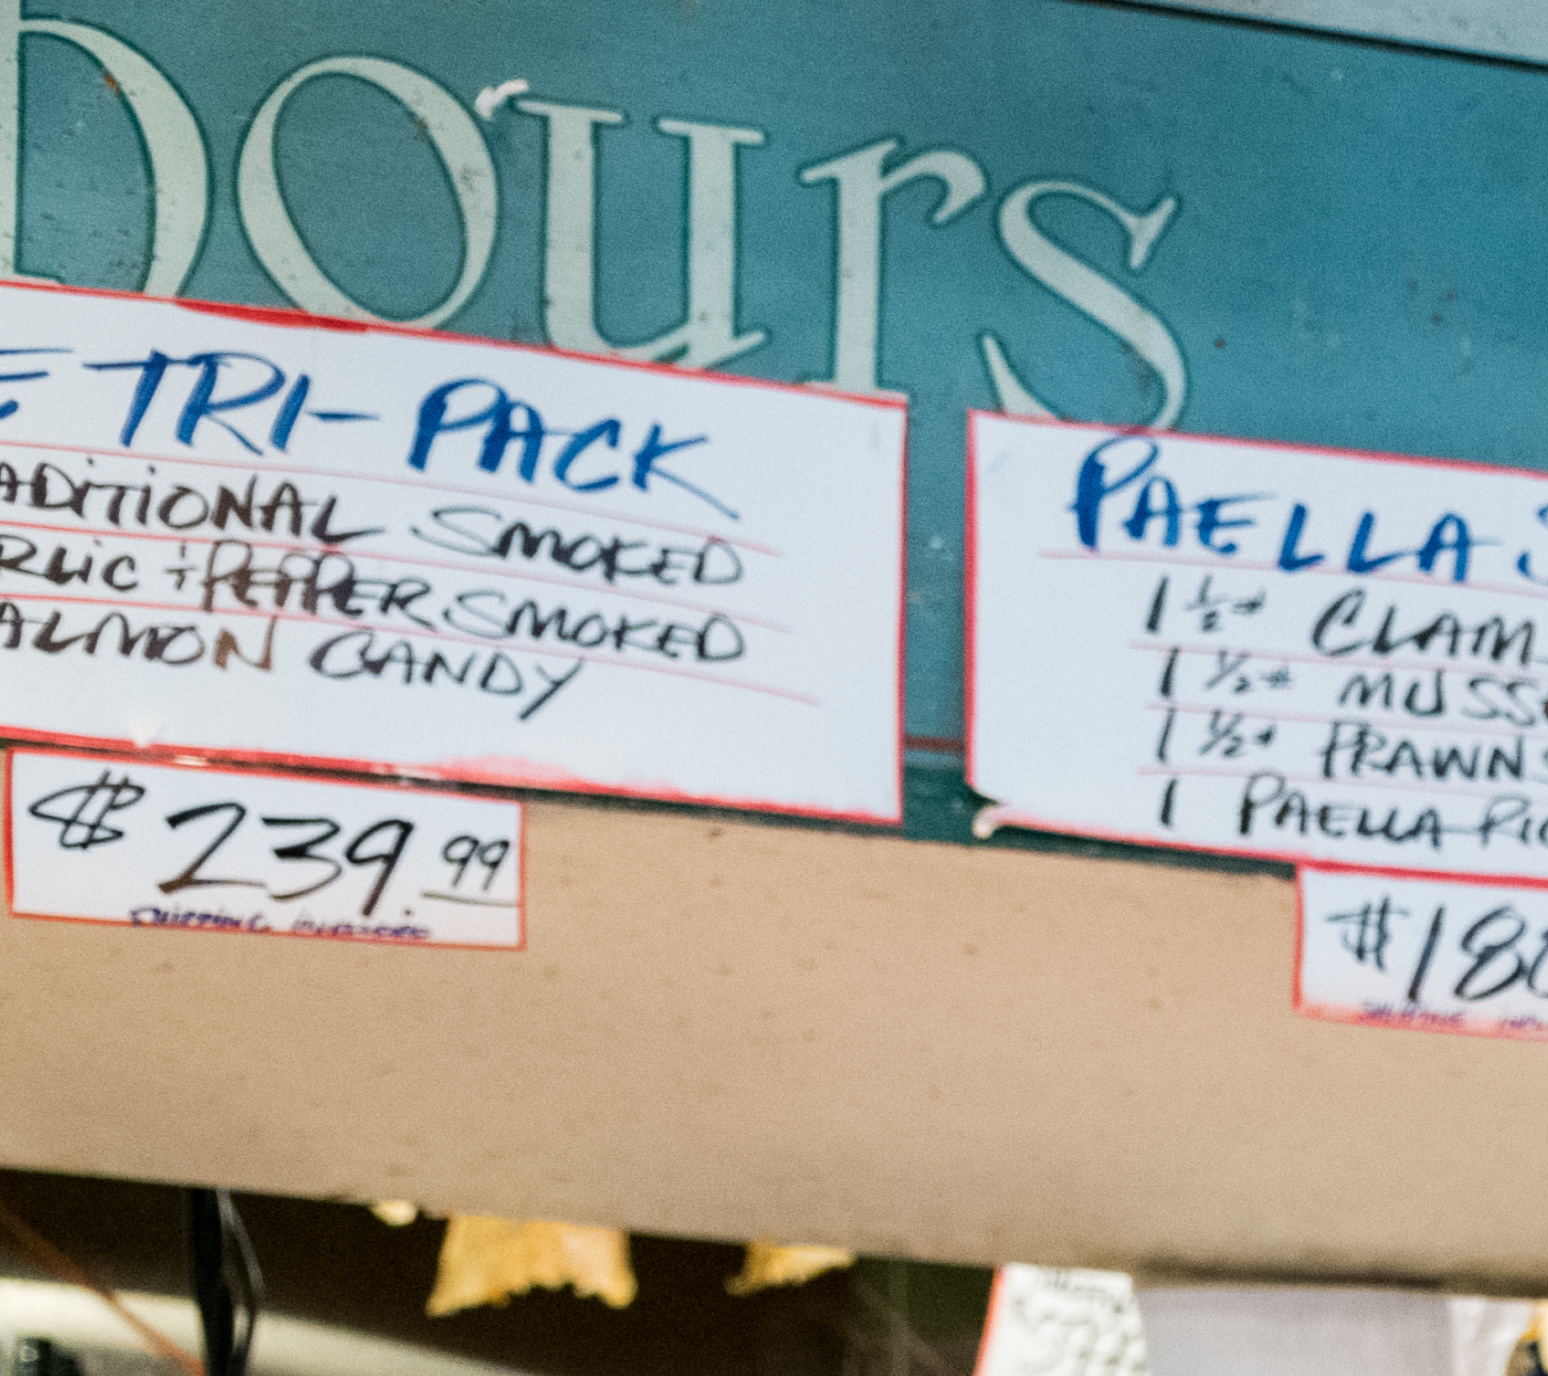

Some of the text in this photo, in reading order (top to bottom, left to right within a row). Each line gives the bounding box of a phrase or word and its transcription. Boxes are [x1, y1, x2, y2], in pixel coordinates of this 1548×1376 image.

[410, 504, 743, 586] SMOKED
[1066, 435, 1502, 584] PAELLA
[202, 539, 442, 634] PEPPER
[443, 589, 745, 663] SMOKED
[309, 629, 586, 722] CANDY
[1238, 772, 1441, 849] PAELLA
